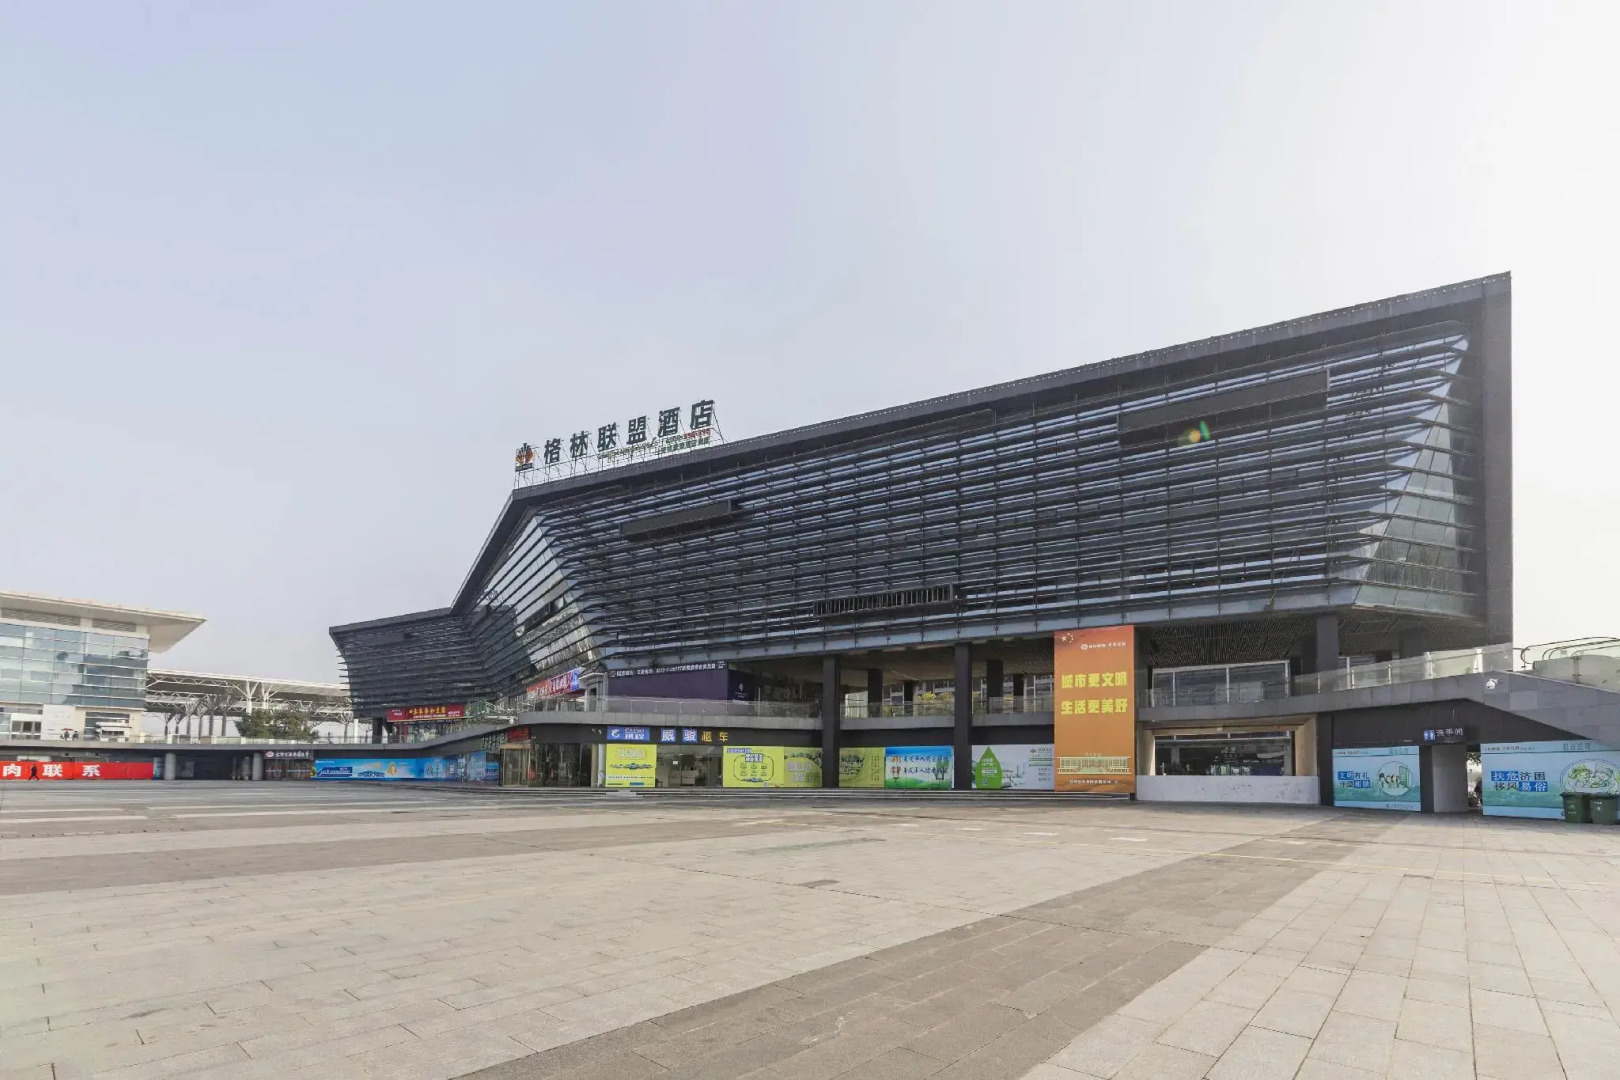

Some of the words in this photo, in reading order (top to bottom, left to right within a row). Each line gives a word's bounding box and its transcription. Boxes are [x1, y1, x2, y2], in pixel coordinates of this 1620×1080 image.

[544, 399, 714, 465] 格林联盟酒店
[1061, 671, 1127, 689] 城市更文明
[1061, 698, 1128, 715] 生活更美好
[1436, 728, 1464, 737] 洗手间
[1339, 771, 1370, 780] 文明有礼
[1493, 771, 1546, 780] 扶危济困
[1493, 781, 1547, 792] 移风易俗
